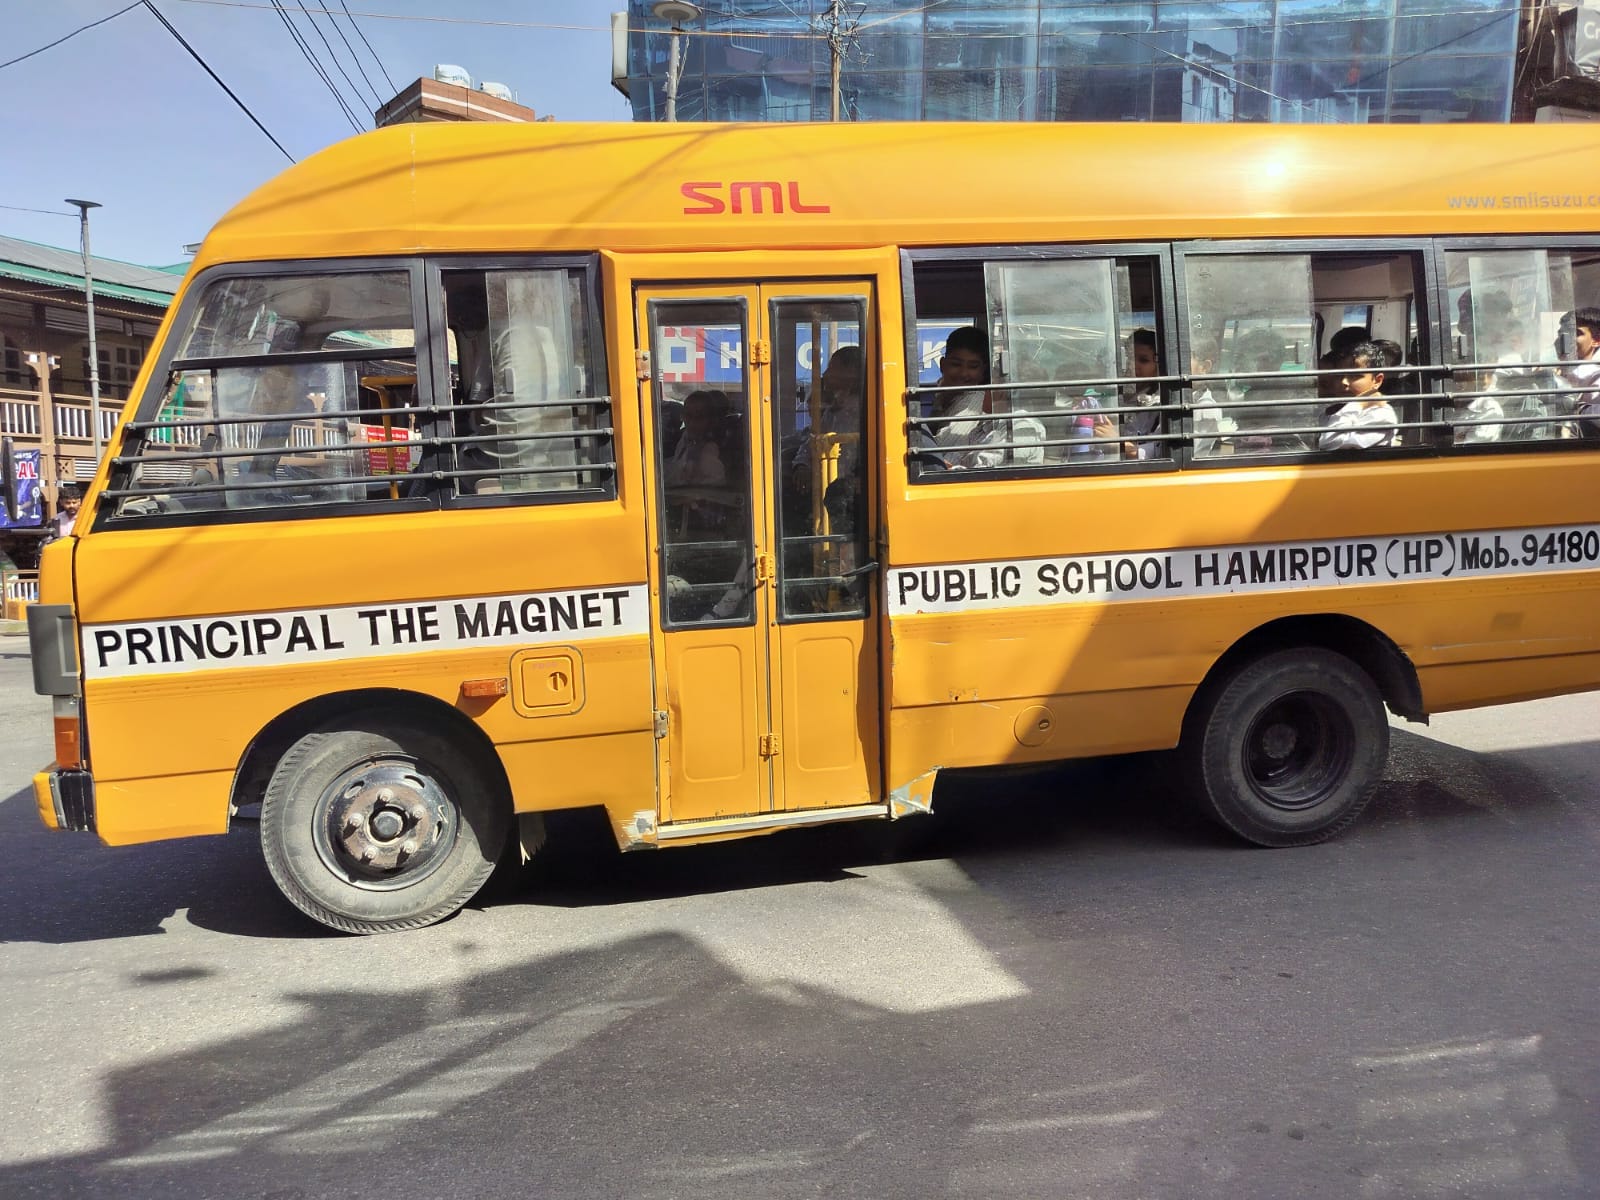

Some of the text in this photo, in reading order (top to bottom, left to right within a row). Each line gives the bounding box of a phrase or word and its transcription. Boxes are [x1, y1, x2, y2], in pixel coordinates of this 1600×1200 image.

[680, 181, 831, 215] SML
[898, 565, 1021, 606] PUBLIC
[1037, 556, 1183, 597] SCHOOL
[1194, 543, 1378, 587] HAMIRPUR
[1385, 533, 1456, 579] (HP)
[95, 590, 630, 667] PRINCIPAL THE MAGNET
